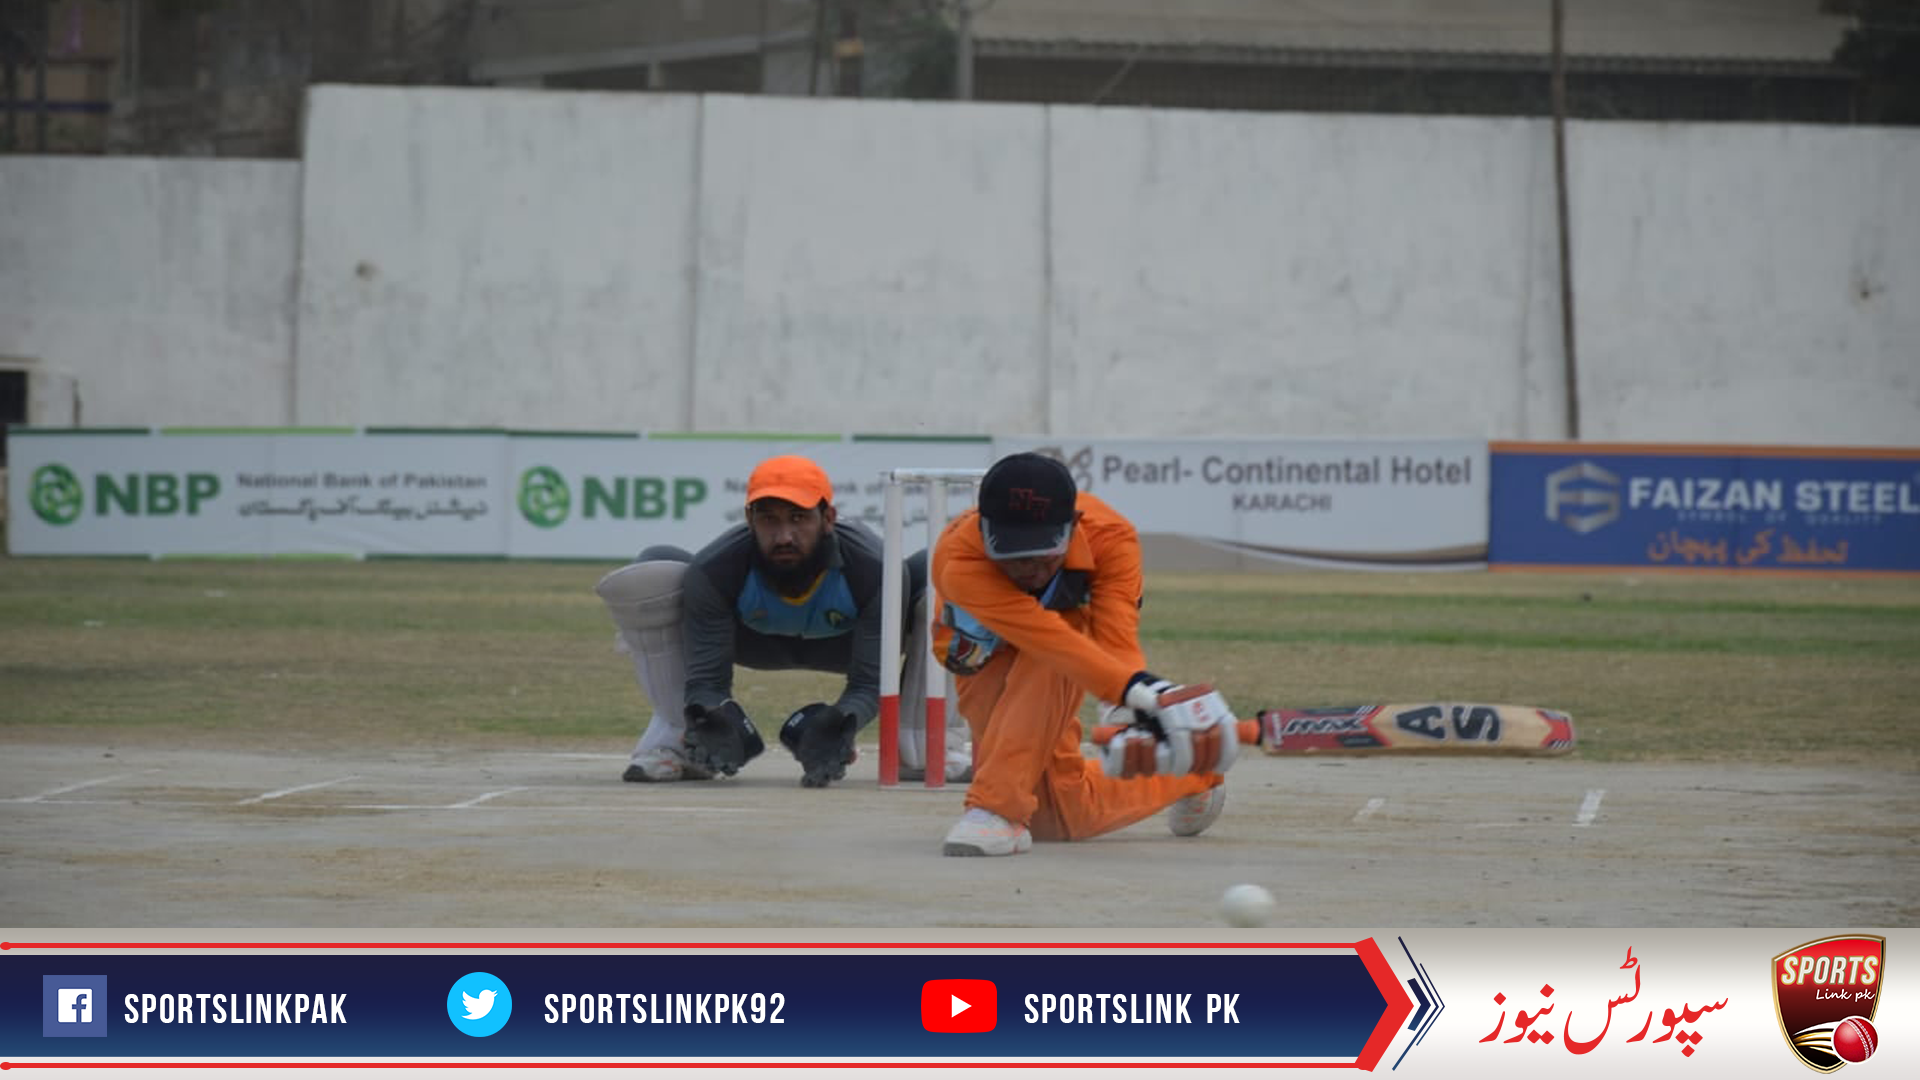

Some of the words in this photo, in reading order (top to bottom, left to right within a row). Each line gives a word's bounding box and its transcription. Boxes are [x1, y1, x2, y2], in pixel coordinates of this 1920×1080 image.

[237, 473, 317, 488] National
[323, 473, 371, 488] Bank
[379, 473, 398, 488] of
[404, 473, 487, 488] Pakistan
[1202, 456, 1381, 485] Continental
[1393, 456, 1472, 486] Hotel
[95, 472, 221, 516] NBP
[582, 477, 708, 521] NBP
[1232, 494, 1332, 512] KARACHI
[1629, 477, 1783, 511] FAIZAN
[1795, 481, 1920, 514] STEEL
